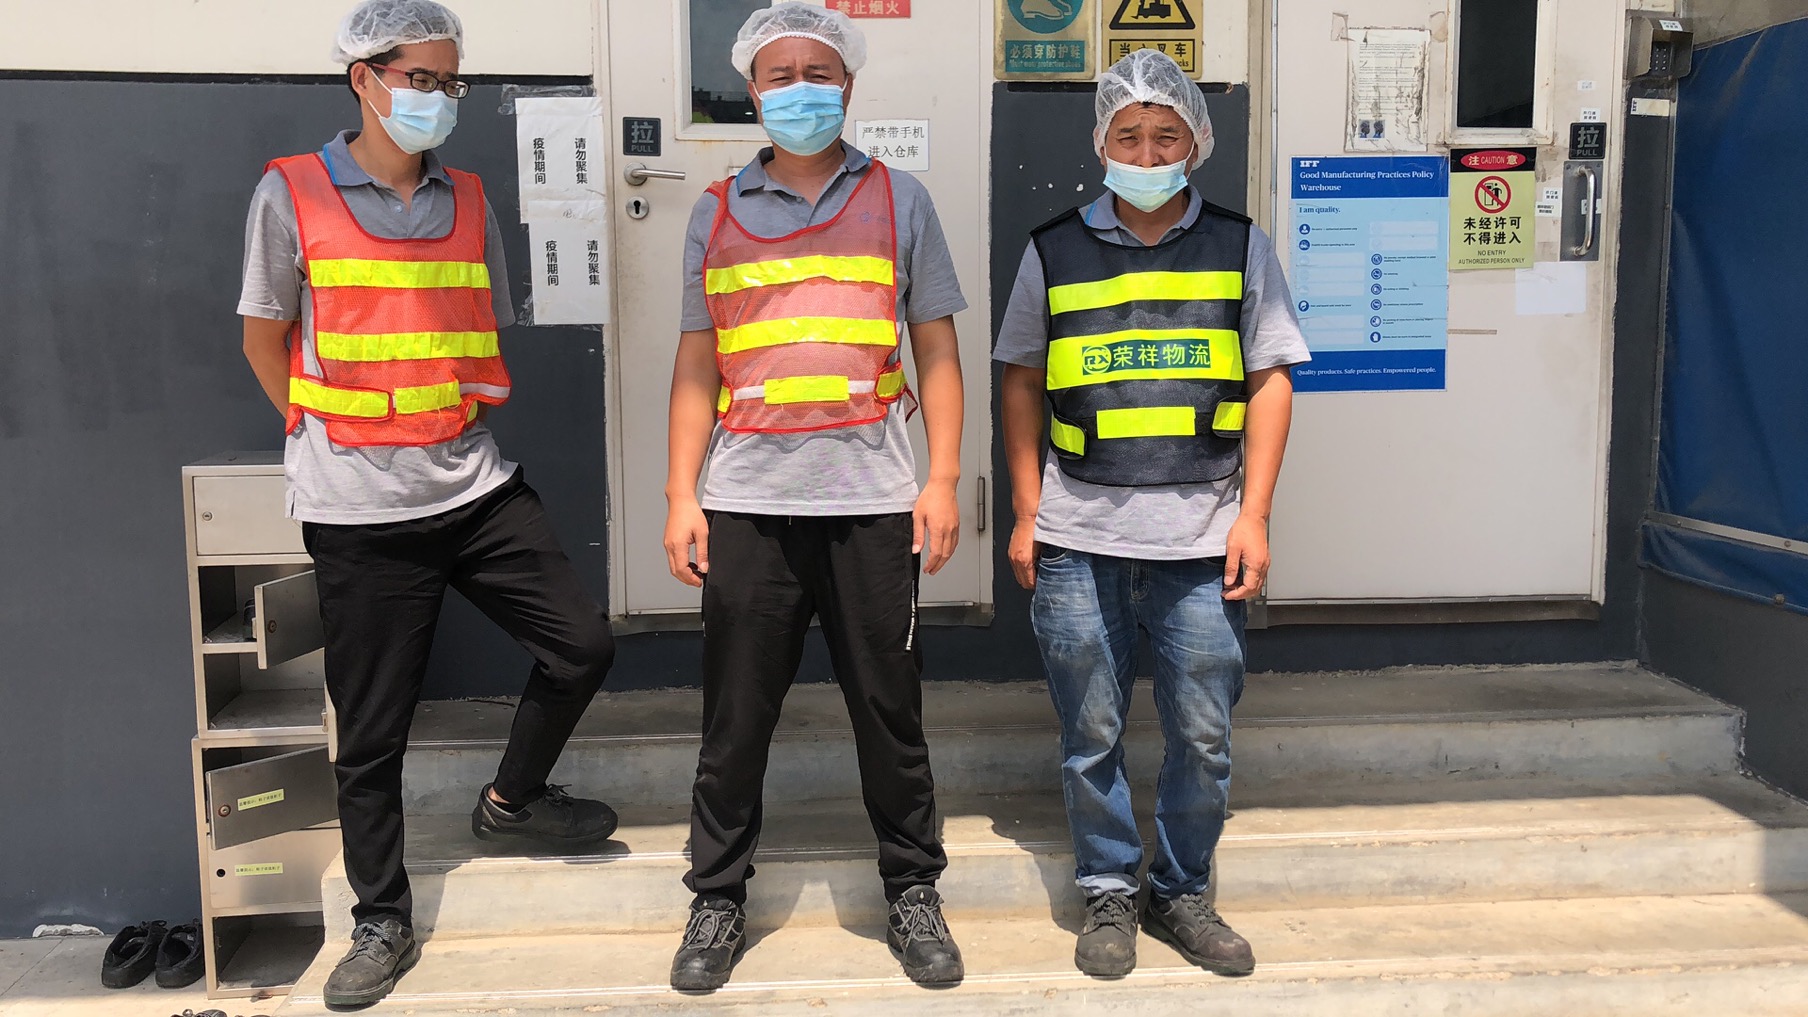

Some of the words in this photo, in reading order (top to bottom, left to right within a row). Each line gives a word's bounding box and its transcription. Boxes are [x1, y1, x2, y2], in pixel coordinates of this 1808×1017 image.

[836, 0, 899, 15] 禁止烟火
[1010, 43, 1081, 59] 必须穿防护鞋
[631, 121, 654, 144] 拉
[862, 126, 925, 139] 严禁带手机
[1577, 126, 1600, 148] 拉
[868, 145, 919, 158] 进入仓库
[533, 138, 546, 184] 疫情期间
[574, 137, 588, 184] 请勿聚集
[1468, 155, 1480, 165] 注
[1506, 154, 1518, 165] 意
[1299, 171, 1320, 179] Good
[1321, 170, 1376, 179] Manufacturing
[1412, 170, 1434, 179] Policy
[1315, 206, 1341, 214] quality.
[1463, 216, 1522, 231] 未经许可
[1463, 231, 1522, 245] 不得进入
[545, 240, 559, 286] 疫情期间
[587, 240, 600, 286] 请勿聚集
[1113, 344, 1211, 368] 荣祥物流
[1317, 368, 1343, 376] products.
[1383, 366, 1416, 375] Empowered
[1416, 366, 1436, 374] people.
